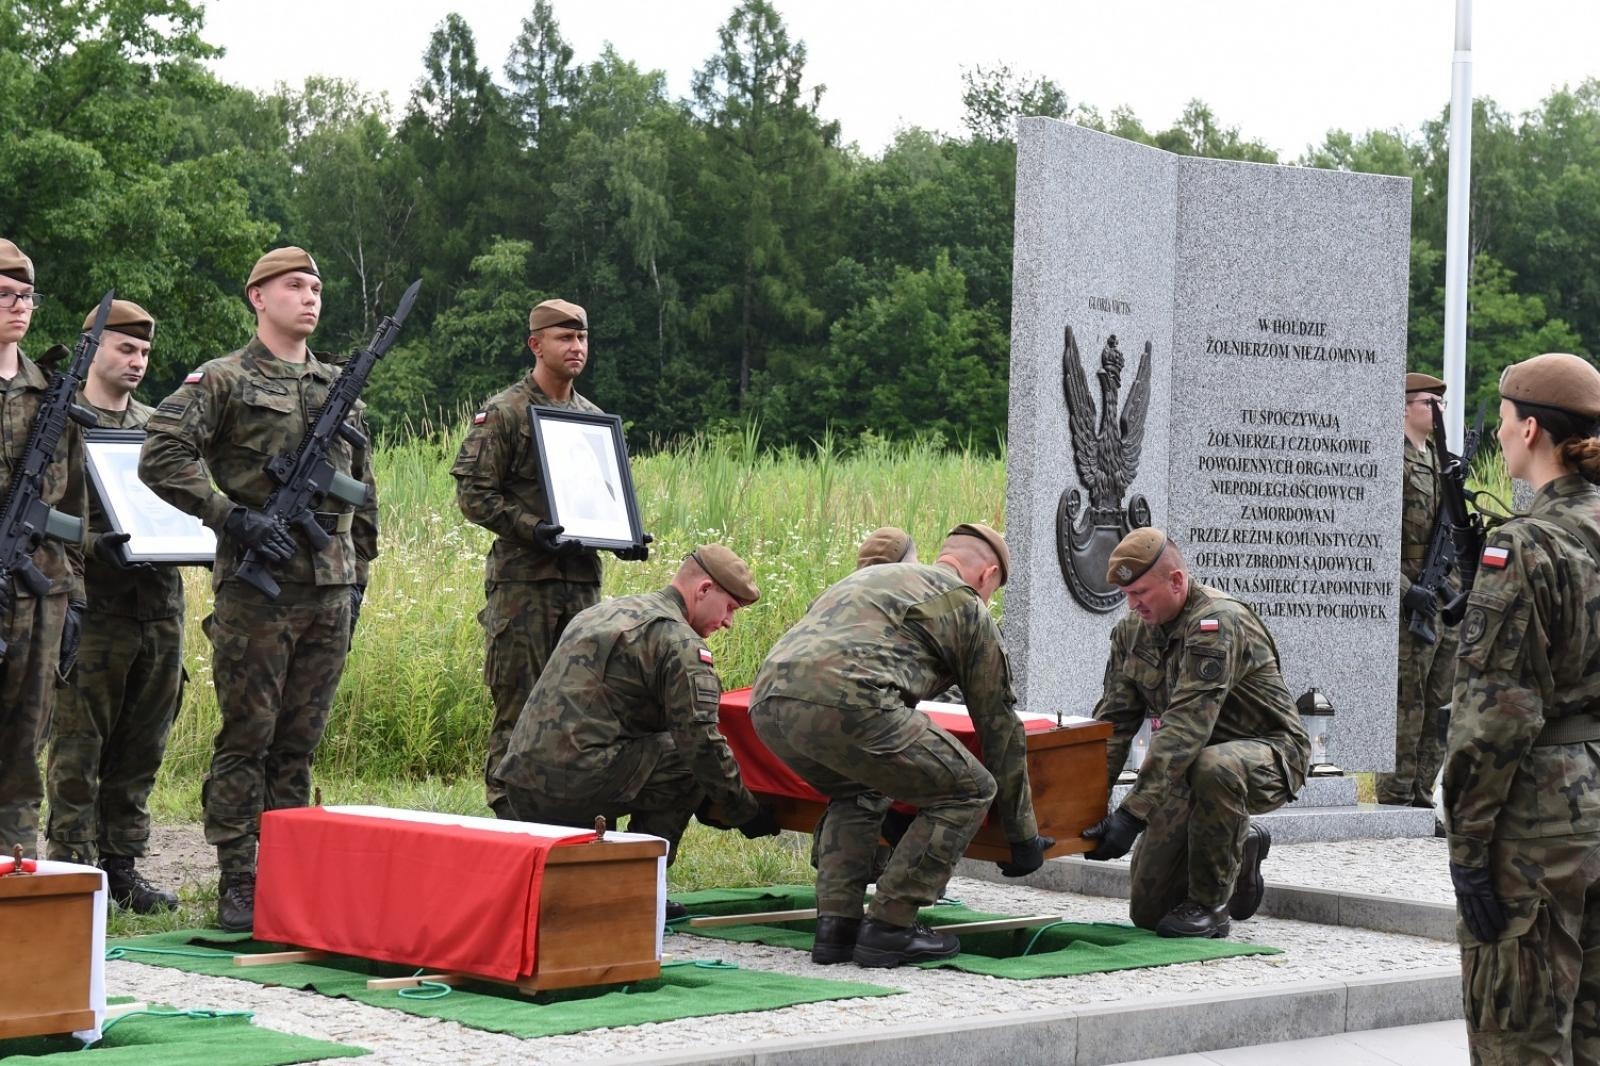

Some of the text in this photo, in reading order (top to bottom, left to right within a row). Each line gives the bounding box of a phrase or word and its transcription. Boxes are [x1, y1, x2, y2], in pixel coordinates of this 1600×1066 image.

[1258, 318, 1270, 332] W
[1293, 344, 1375, 364] NIEZŁOMNYM
[1241, 409, 1340, 431] TU SPOCZYWAJĄ
[1207, 428, 1371, 454] ŻOŁNIERZE I CZŁONKOWIE
[1199, 456, 1378, 478] POWOJENNYCH ORGANIZACJI
[1211, 480, 1364, 500] NIEPODLEGŁOŚCIOWYCH
[1241, 505, 1335, 523] ZAMORDOWANI
[1190, 526, 1383, 549] PRZEZ REŻIM KOMUNISTYCZNY,
[1196, 553, 1375, 573] OFIARY ZBRODNI SĄDOWYCH,
[1234, 577, 1250, 593] NA
[1252, 574, 1300, 595] ŚMIERĆ
[1303, 580, 1307, 595] I
[1310, 579, 1393, 596] ZAPOMNIENIE
[1249, 601, 1387, 620] OTAJEMNY POCHÓWEK
